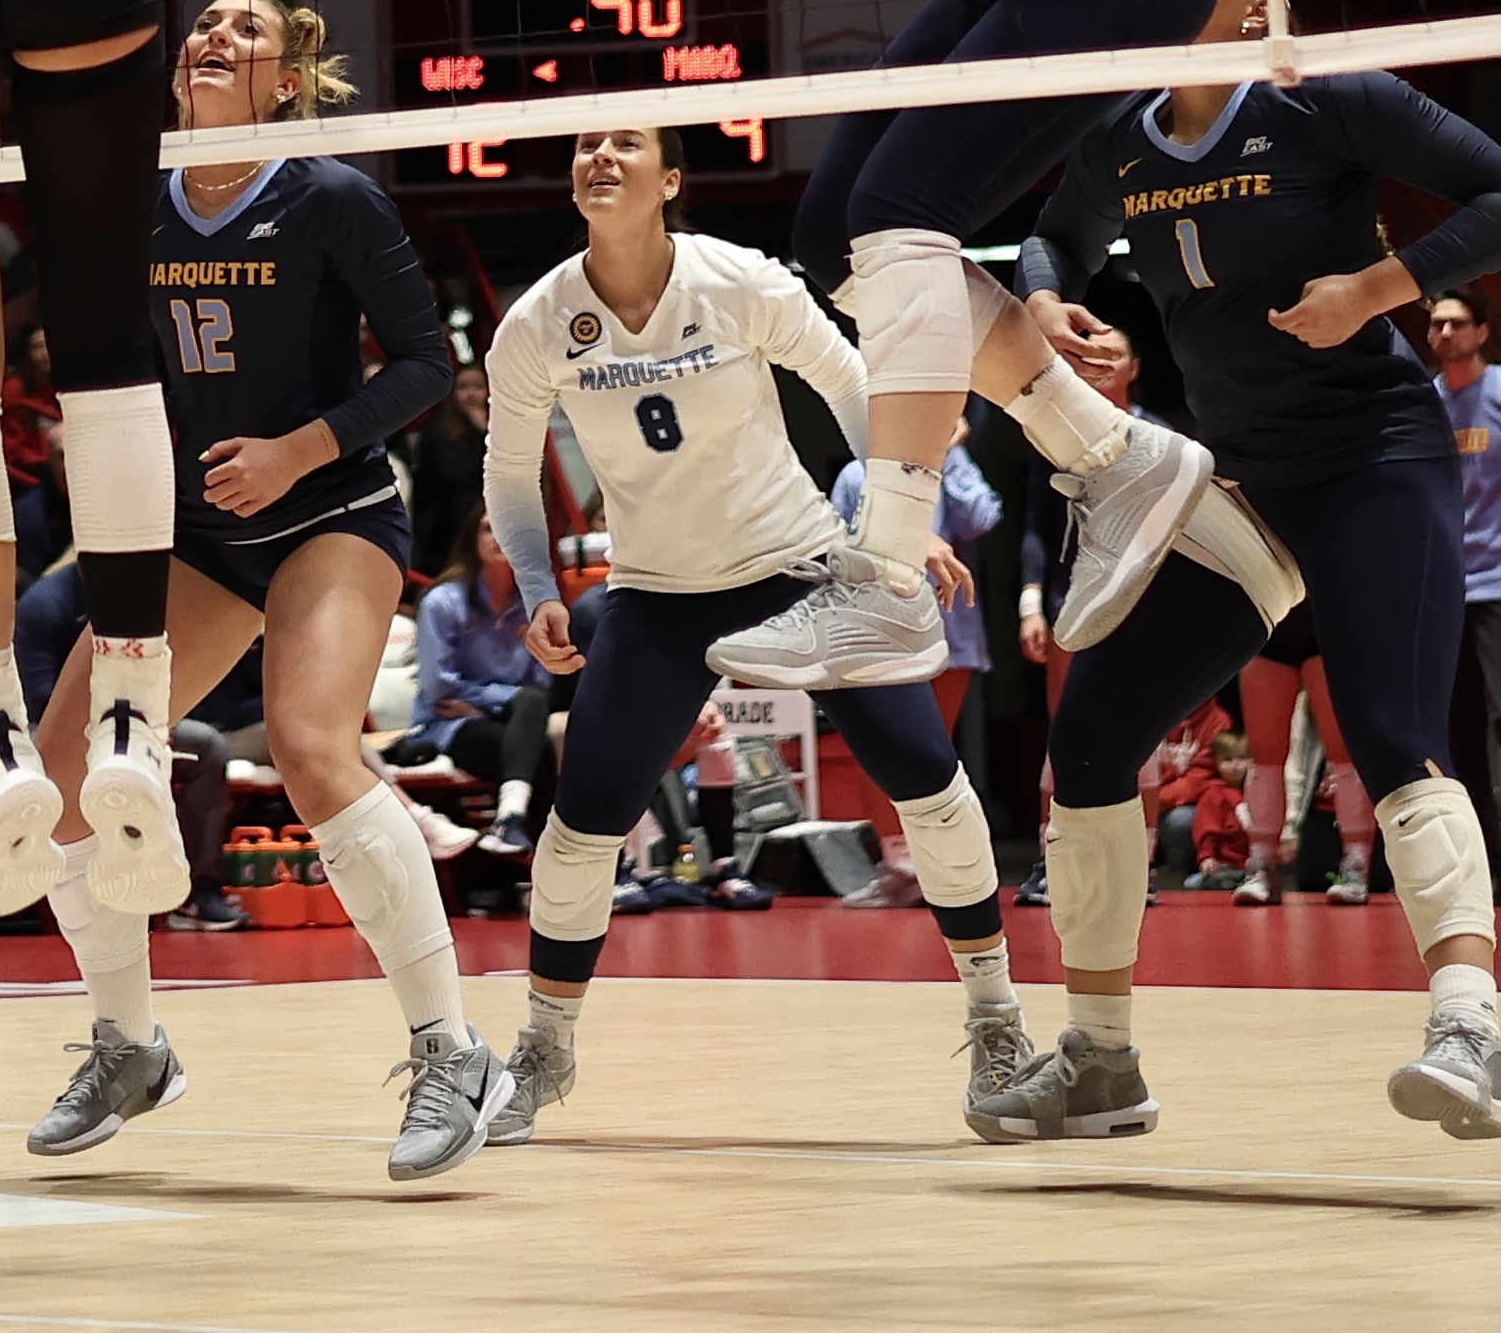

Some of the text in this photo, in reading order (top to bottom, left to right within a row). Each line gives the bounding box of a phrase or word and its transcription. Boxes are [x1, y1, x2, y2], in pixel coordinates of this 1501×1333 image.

[1174, 217, 1217, 291] 1
[169, 298, 237, 373] 12
[577, 344, 719, 390] MARQUETTE
[635, 394, 683, 452] 8
